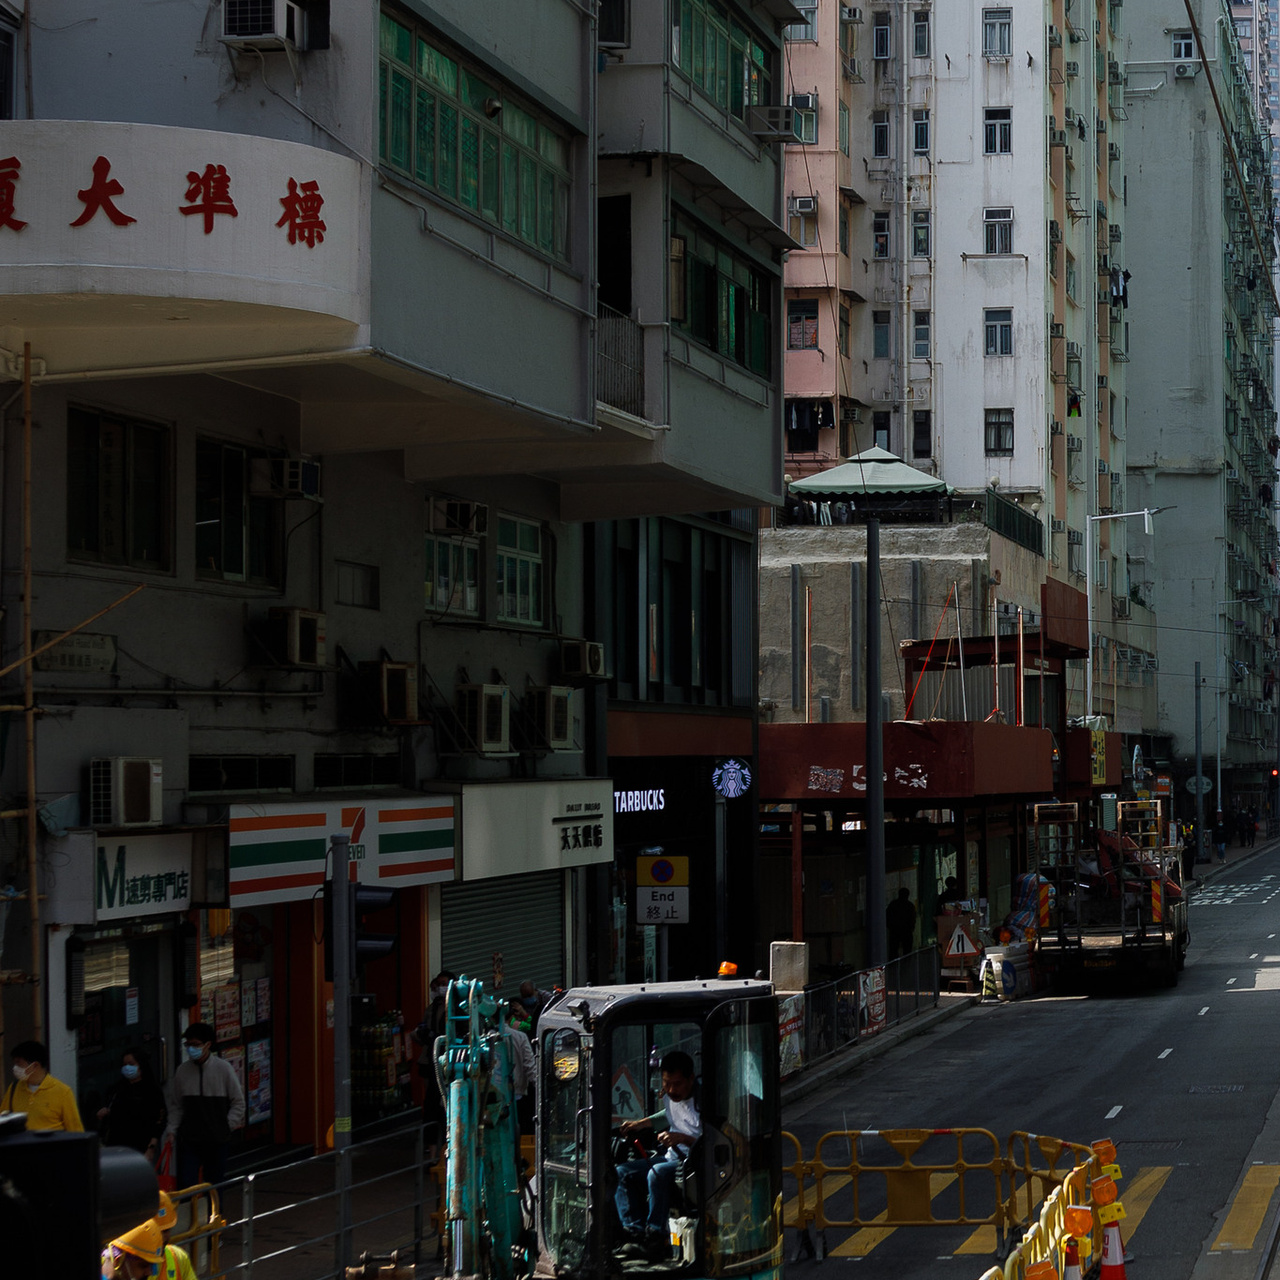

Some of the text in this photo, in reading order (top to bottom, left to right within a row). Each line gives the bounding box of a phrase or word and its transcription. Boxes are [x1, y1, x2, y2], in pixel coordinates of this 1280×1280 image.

[614, 788, 666, 813] TARBUCKS
[97, 845, 126, 909] M
[651, 891, 675, 902] End
[646, 905, 679, 920] 終止
